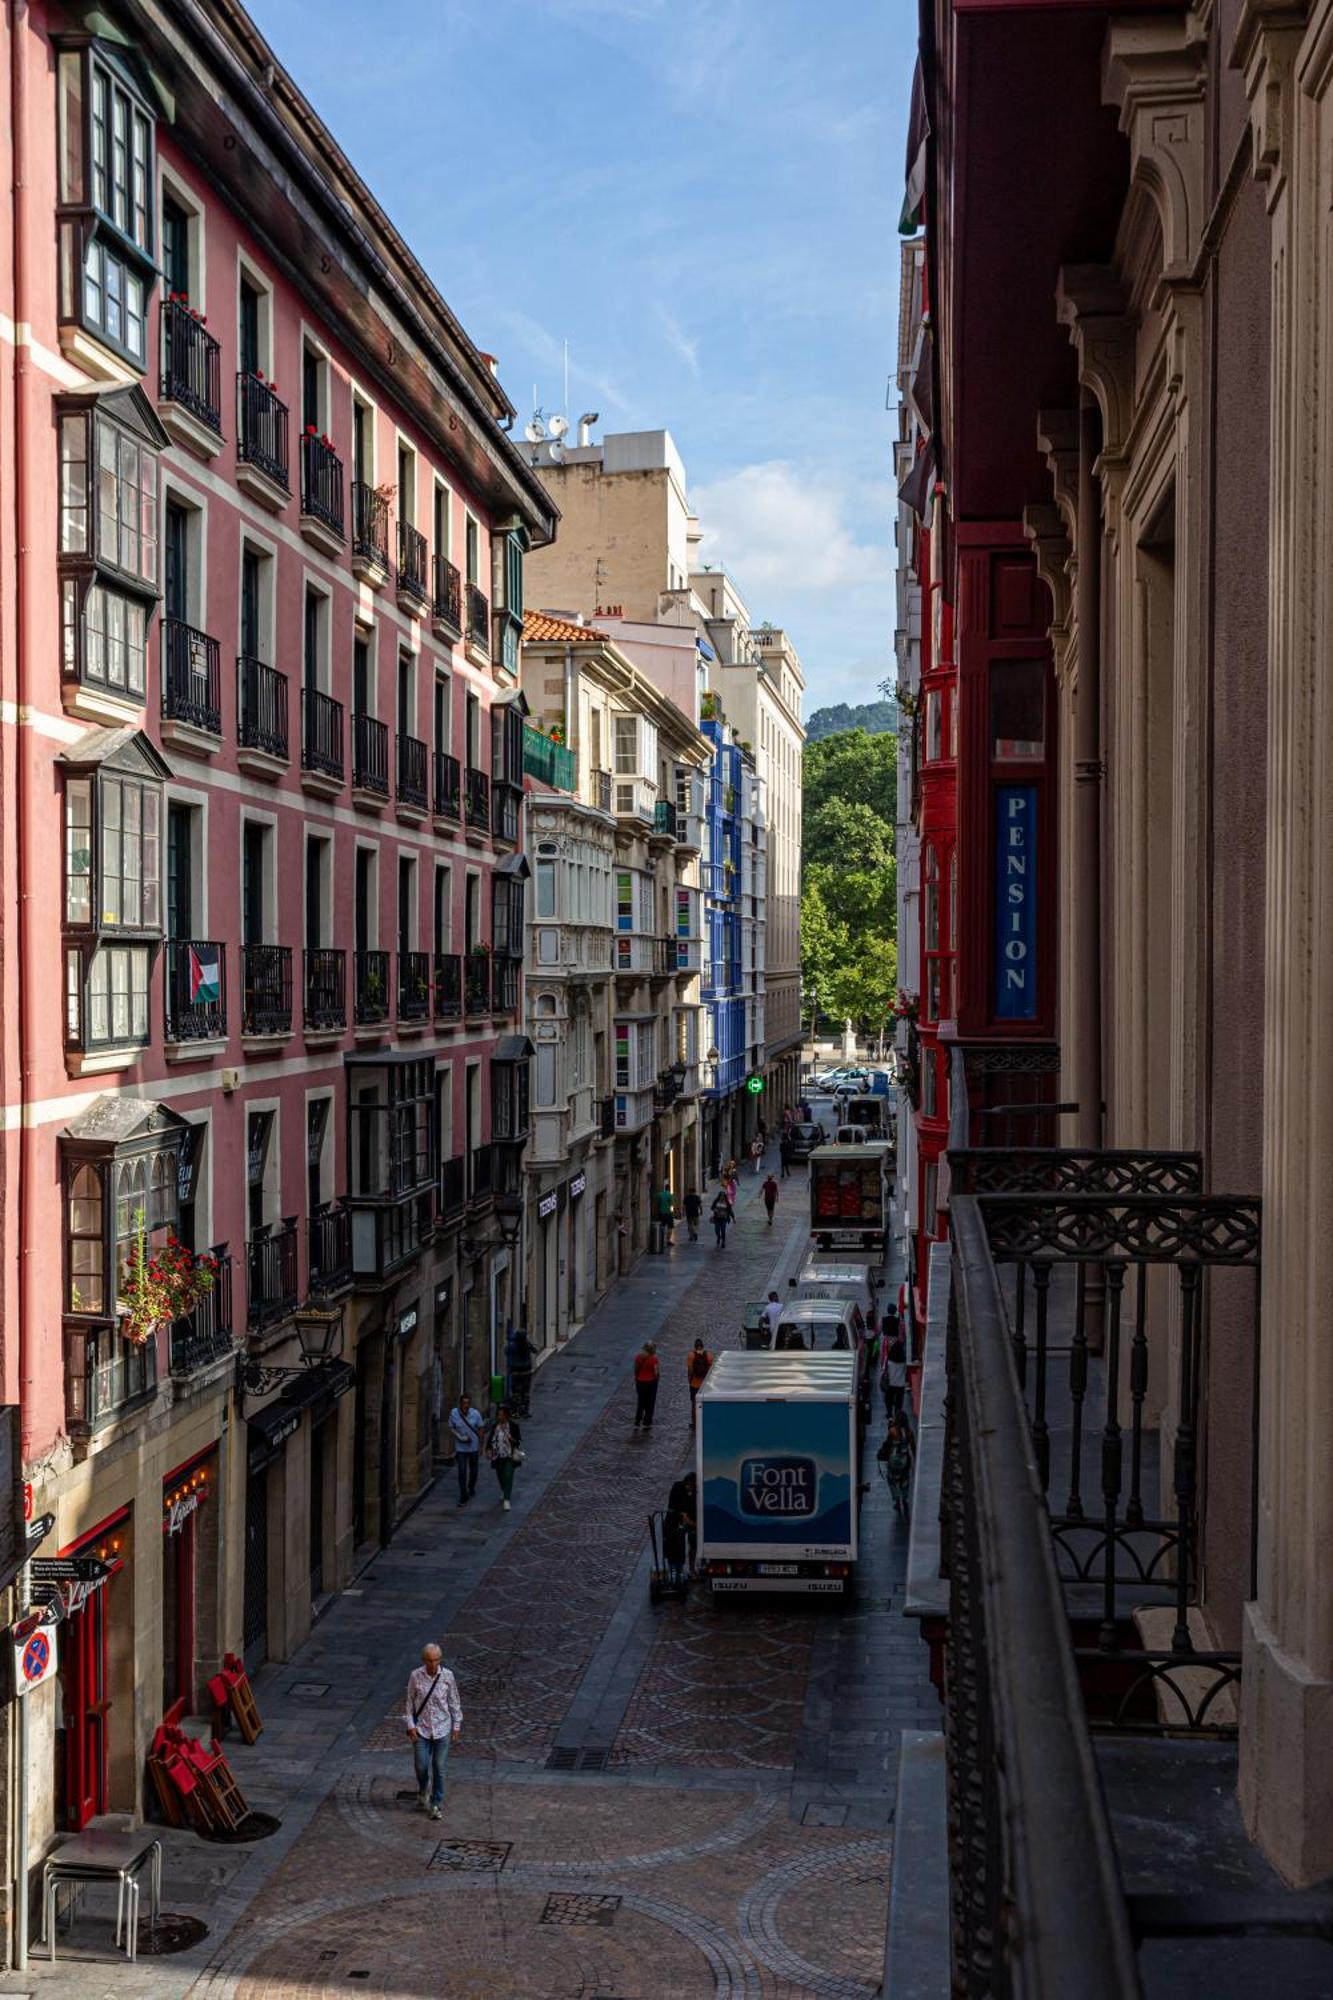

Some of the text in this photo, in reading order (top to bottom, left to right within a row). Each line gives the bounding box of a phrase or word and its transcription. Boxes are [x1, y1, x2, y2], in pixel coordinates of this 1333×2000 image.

[1005, 798, 1027, 989] PENSION
[748, 1464, 808, 1486] Font
[748, 1486, 810, 1511] Vella
[714, 1582, 747, 1590] ISUZU
[808, 1583, 842, 1591] ISUZU
